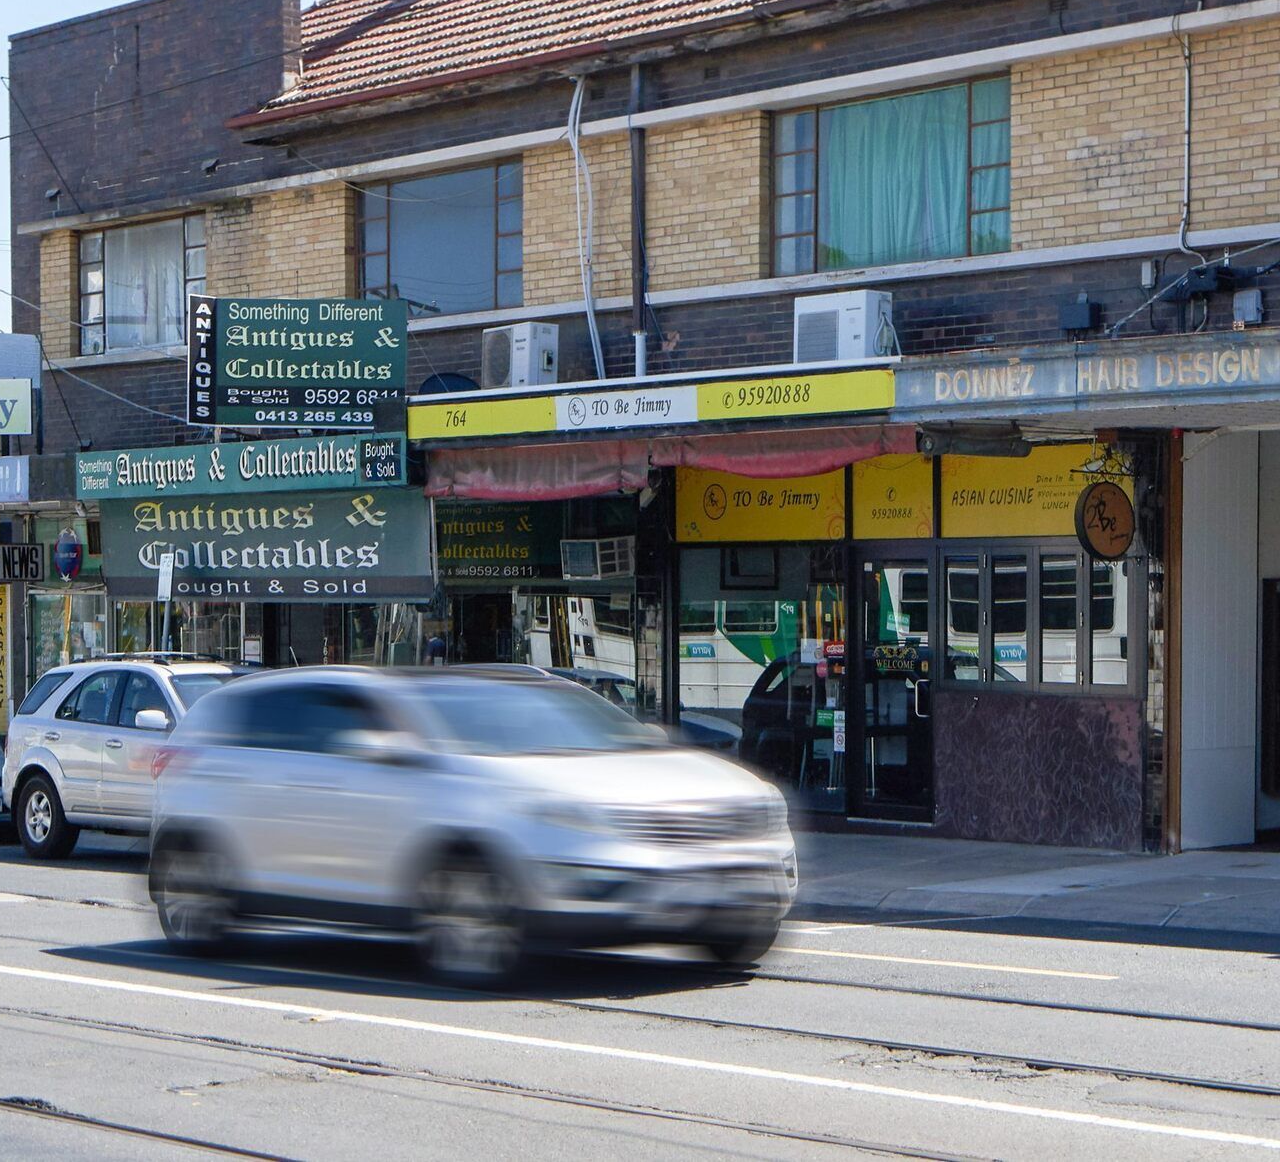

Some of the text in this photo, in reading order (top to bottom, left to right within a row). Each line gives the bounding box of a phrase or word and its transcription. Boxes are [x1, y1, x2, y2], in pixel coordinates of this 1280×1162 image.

[228, 302, 383, 325] Something Different
[373, 326, 400, 348] &
[195, 303, 212, 418] ANTIQUES
[225, 357, 393, 380] Collectables
[1077, 357, 1139, 393] HAIR
[1155, 348, 1261, 387] DESIGN
[227, 388, 289, 397] Bought
[227, 396, 290, 404] & Sold
[304, 389, 350, 405] 9592
[445, 383, 811, 428] 764 TO Be Jimmy 95920888
[255, 410, 374, 422] 0413 265 439
[365, 442, 395, 460] Bought
[78, 458, 113, 476] Something
[208, 447, 226, 481] &
[239, 440, 358, 479] Collectables
[365, 463, 396, 477] & Sold
[81, 474, 110, 491] Different
[733, 489, 821, 510] TO Be Jimmy
[951, 486, 1035, 507] ASIAN CUISINE
[1041, 501, 1069, 510] LUNCH
[344, 493, 388, 527] &
[871, 508, 913, 520] 95920888
[138, 538, 380, 570] Collectables
[438, 542, 530, 559] ollectables
[2, 546, 39, 579] NEWS
[468, 565, 500, 577] 9592
[503, 565, 534, 577] 6811
[177, 579, 367, 596] ought & Sold
[874, 658, 916, 670] WELCOME
